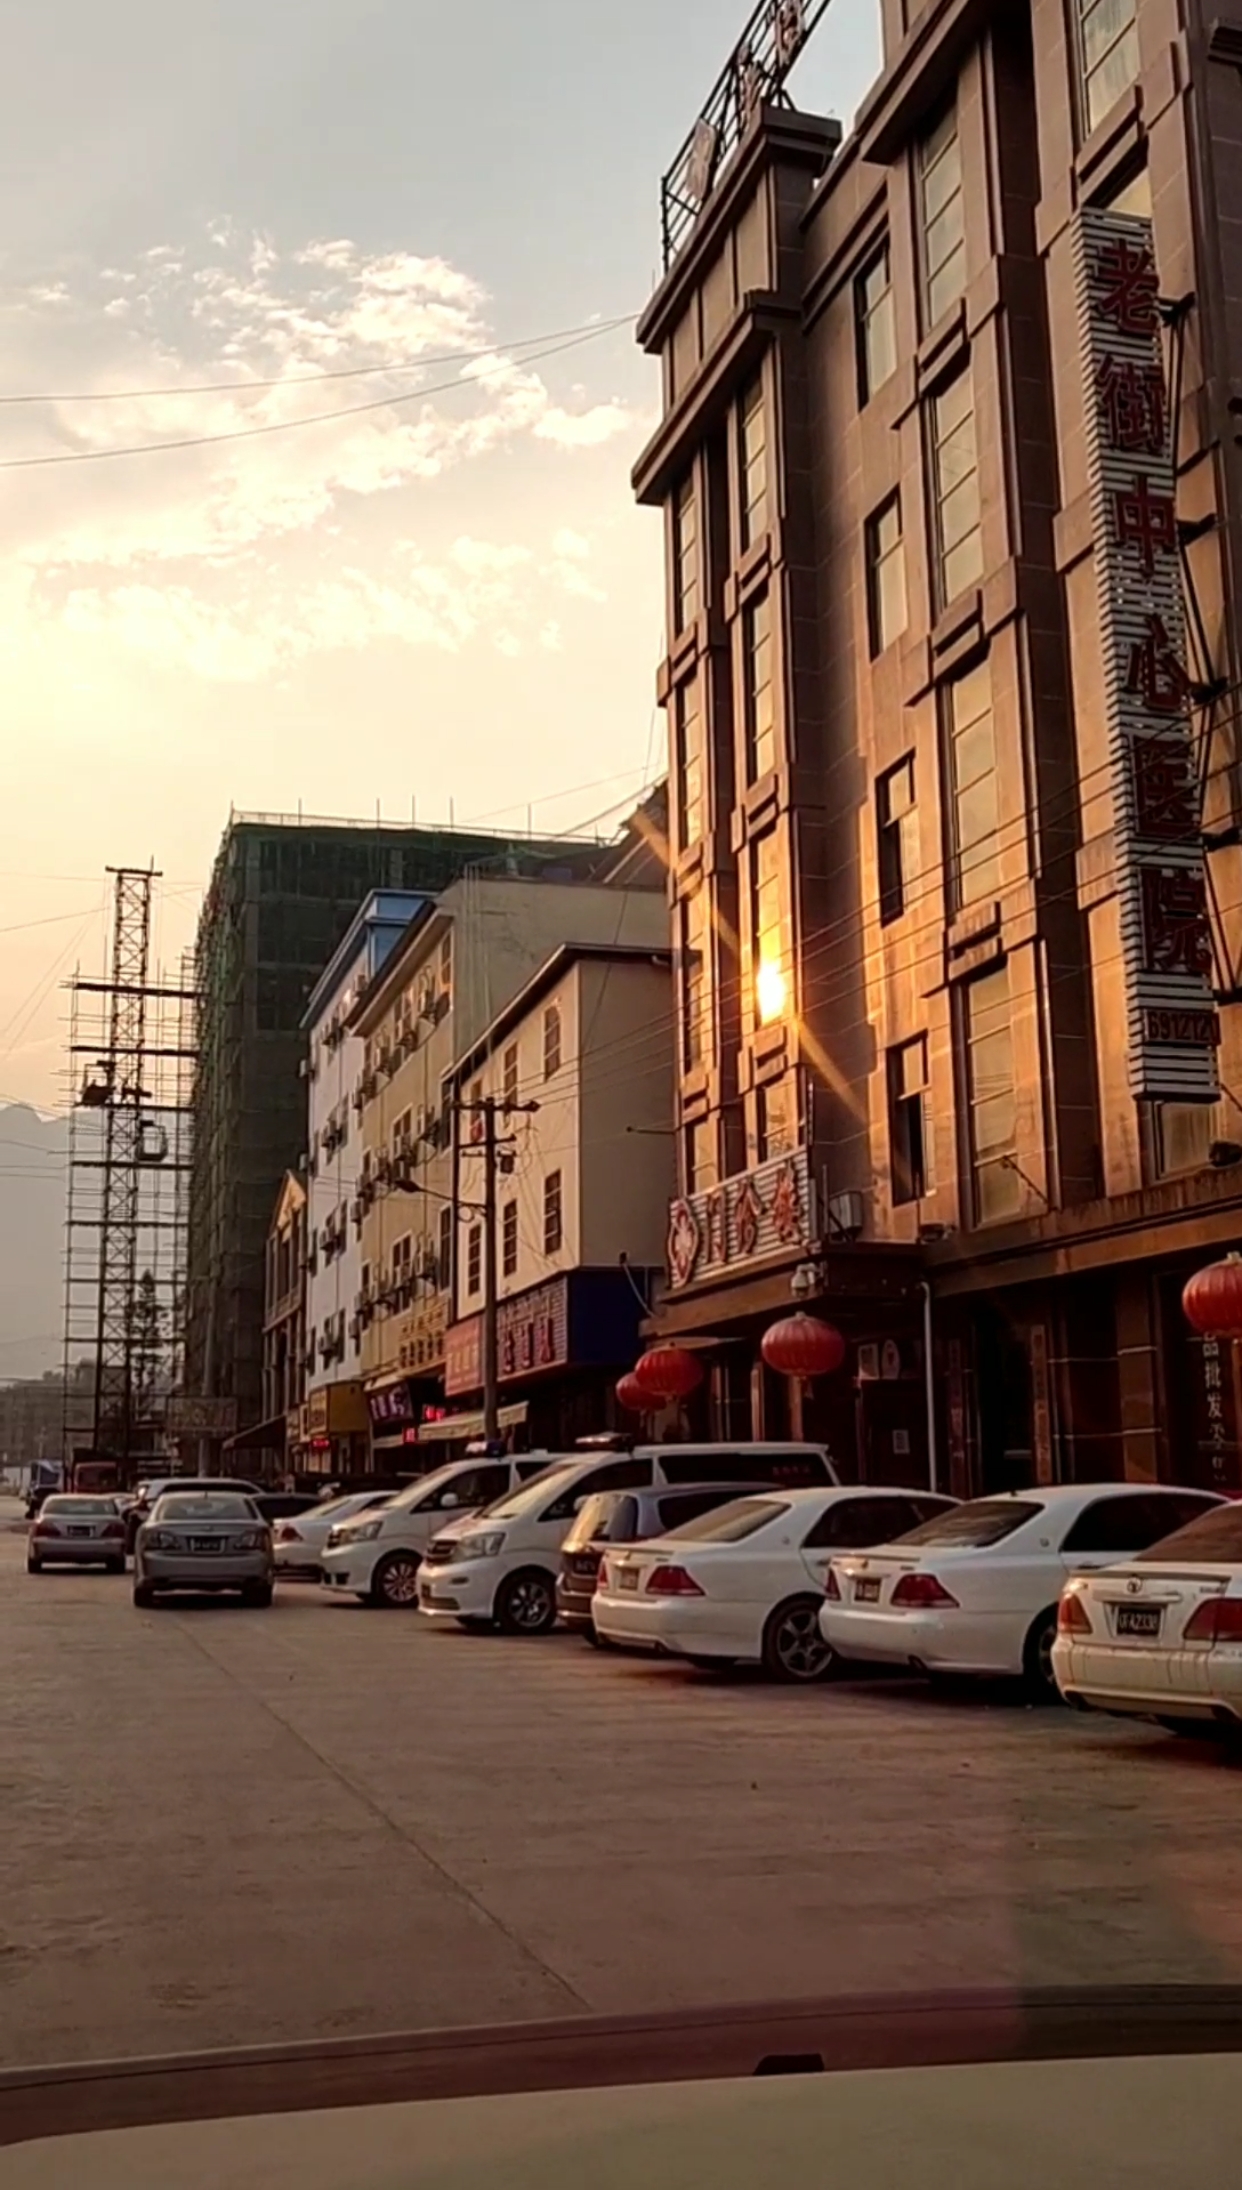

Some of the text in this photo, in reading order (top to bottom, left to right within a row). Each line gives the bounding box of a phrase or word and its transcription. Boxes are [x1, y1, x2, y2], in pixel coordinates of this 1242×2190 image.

[1094, 237, 1214, 974] 老街中心医院
